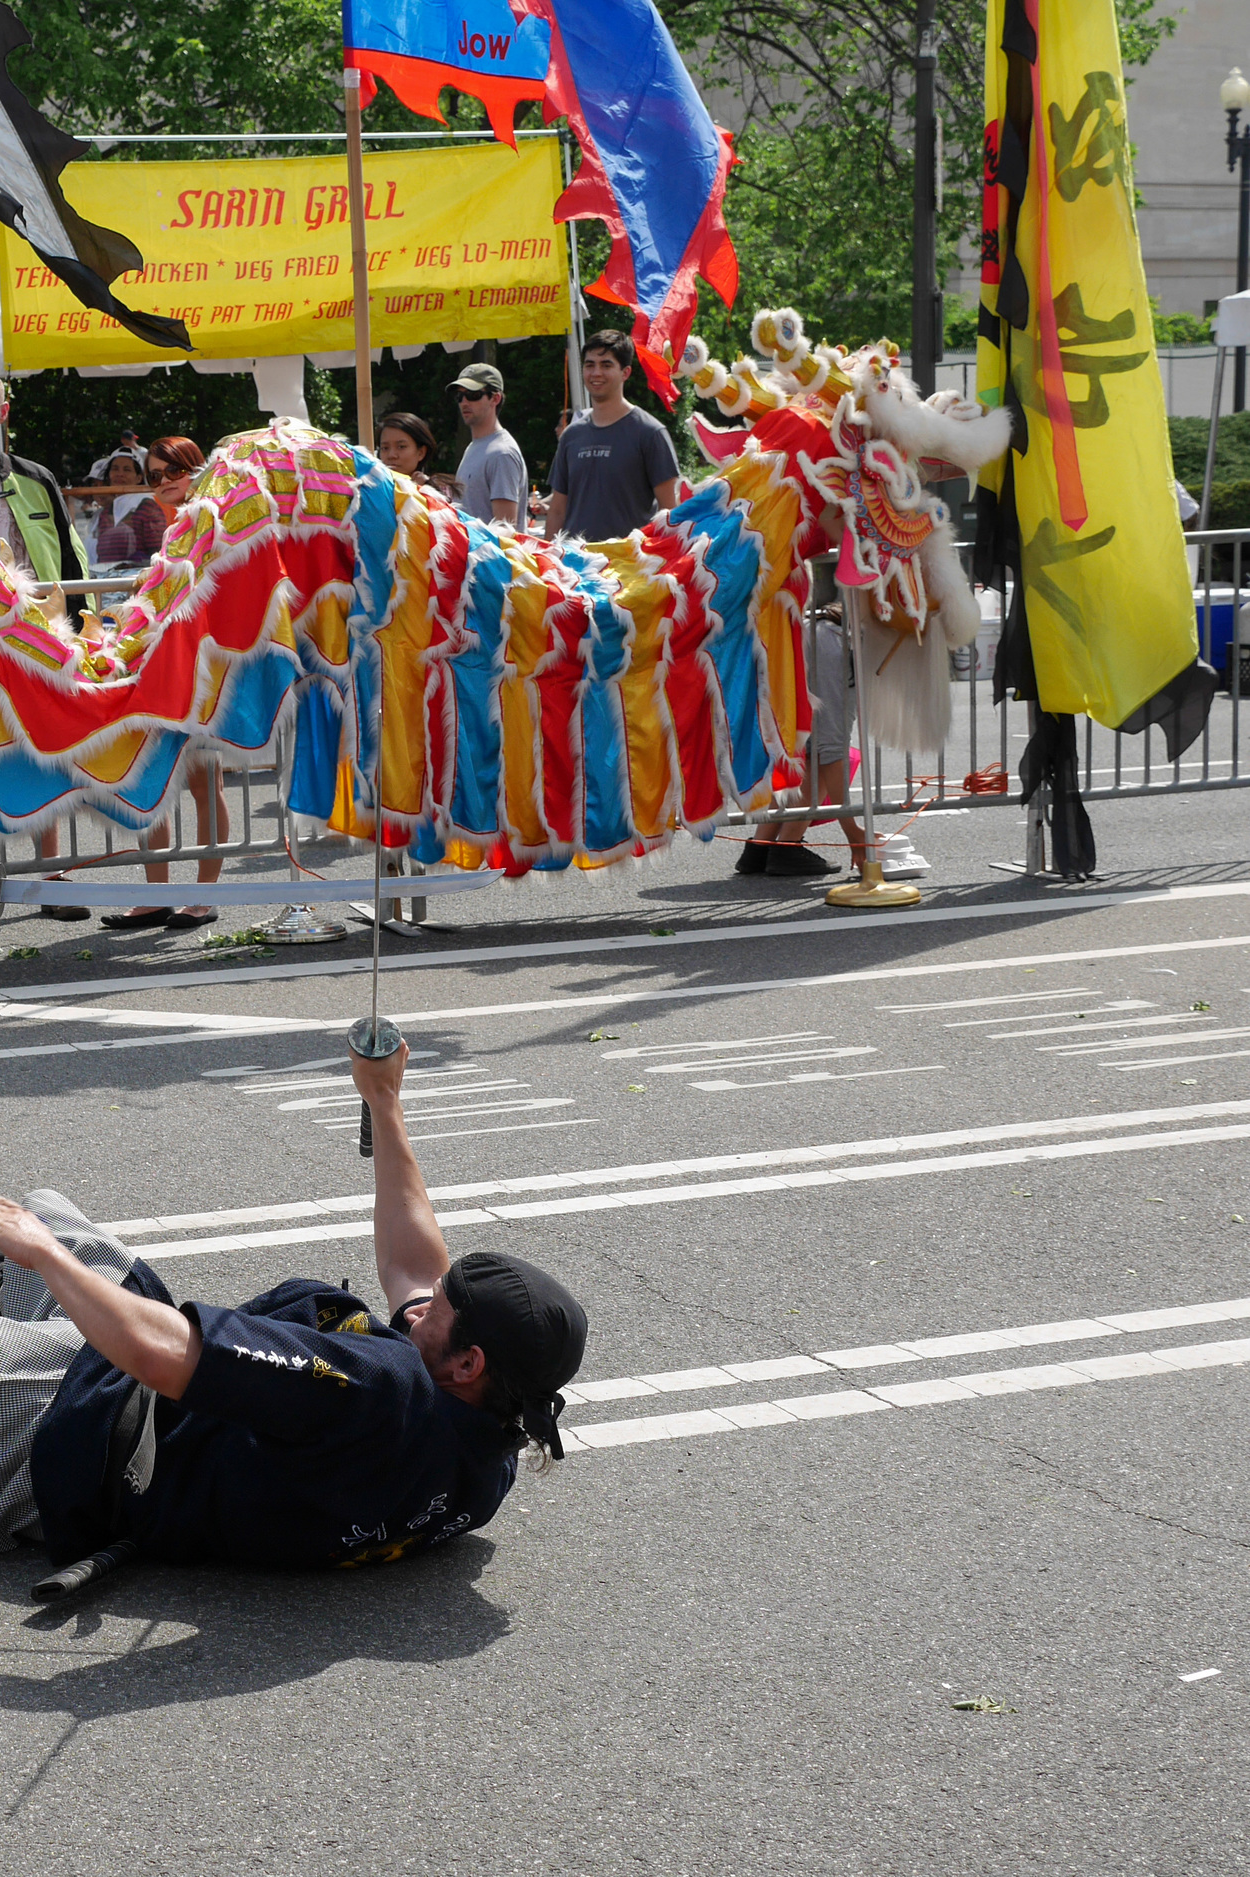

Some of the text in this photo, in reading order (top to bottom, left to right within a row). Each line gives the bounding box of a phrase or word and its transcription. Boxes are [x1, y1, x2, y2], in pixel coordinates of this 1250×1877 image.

[170, 181, 404, 231] SARIN GRLL
[123, 262, 208, 285] CHICKEN
[235, 260, 273, 282] VEG
[284, 255, 339, 278] FRIED
[414, 245, 452, 268] VEG
[463, 238, 551, 263] LO-MEIN
[13, 313, 49, 335] VEG
[56, 311, 92, 333] EGG
[210, 304, 245, 324] PAT
[254, 302, 293, 322] THAI
[385, 292, 444, 314] WATER
[468, 284, 561, 308] LEMONADE
[593, 449, 611, 458] LIFE
